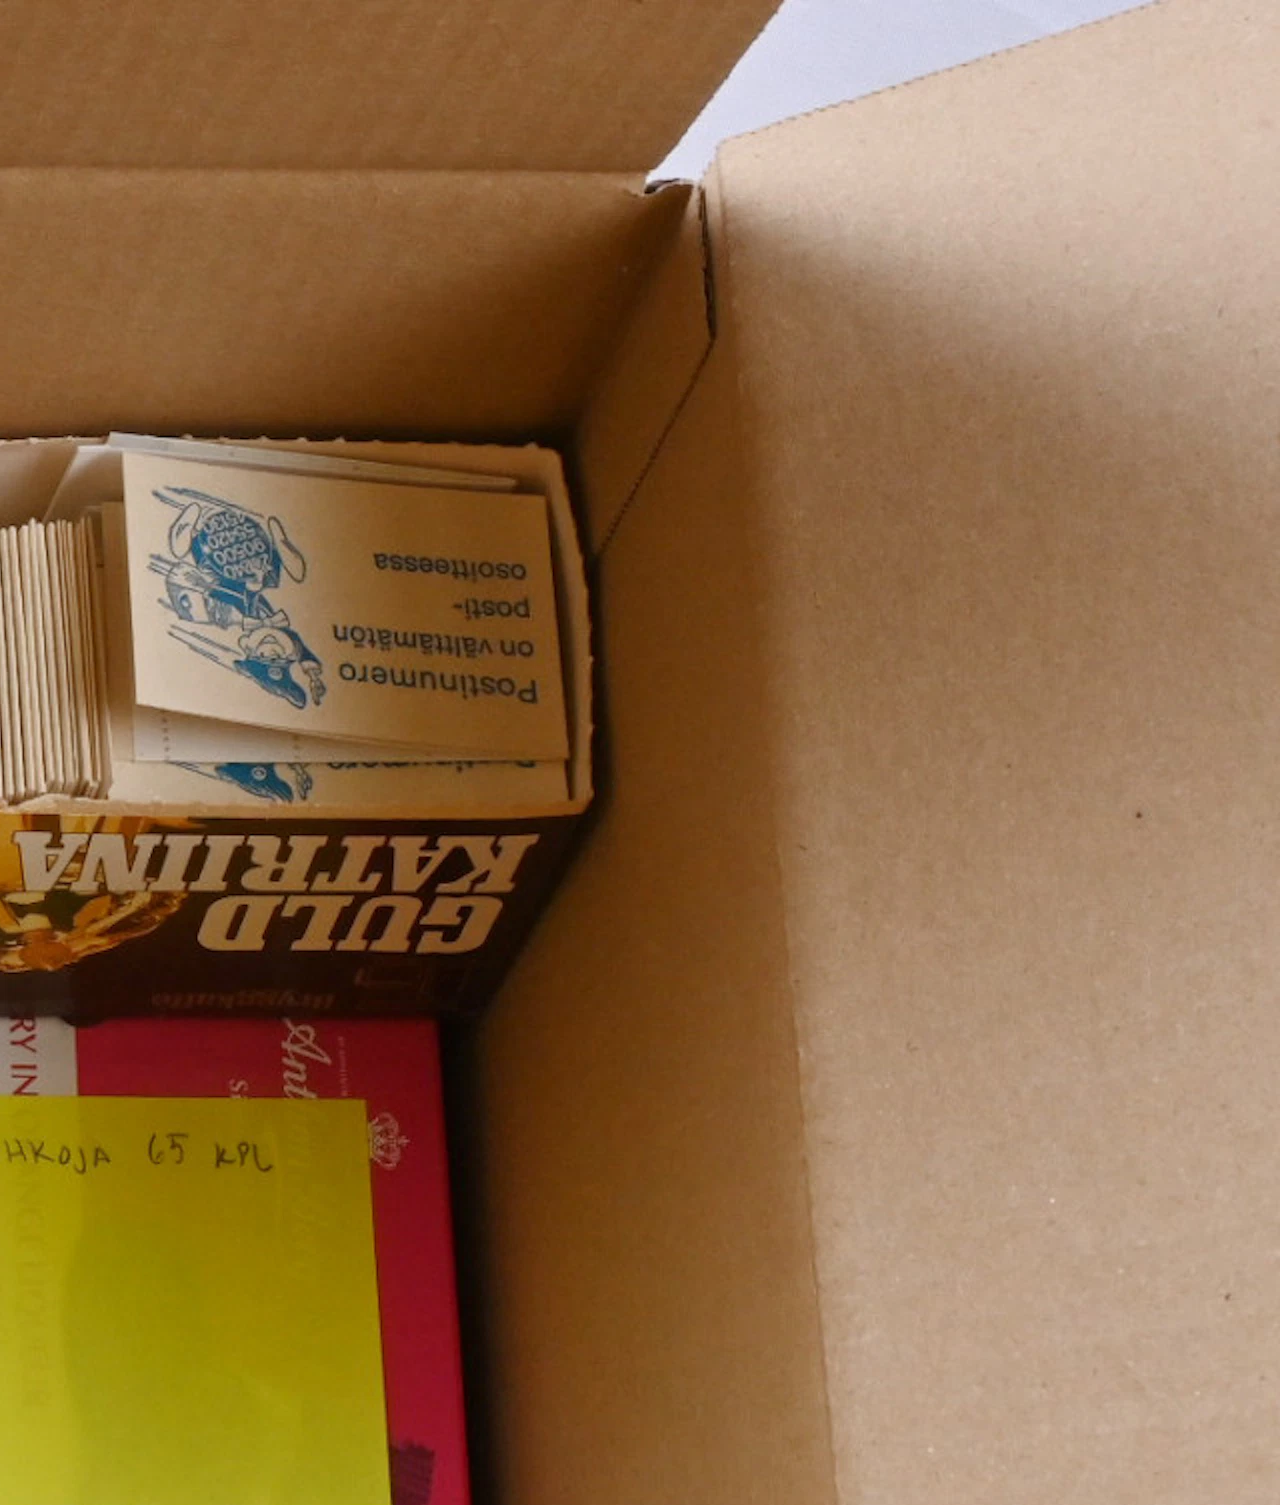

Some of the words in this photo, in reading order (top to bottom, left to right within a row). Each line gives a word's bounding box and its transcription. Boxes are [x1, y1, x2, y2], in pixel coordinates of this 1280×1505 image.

[373, 552, 527, 582] osoitteessa
[453, 597, 530, 621] posti-
[332, 624, 493, 658] välttämätön
[500, 640, 534, 657] on
[339, 663, 538, 704] Postinumero
[12, 832, 539, 893] KATRINA
[196, 895, 503, 954] GULD
[148, 1133, 190, 1166] 65
[215, 1142, 273, 1173] KPL
